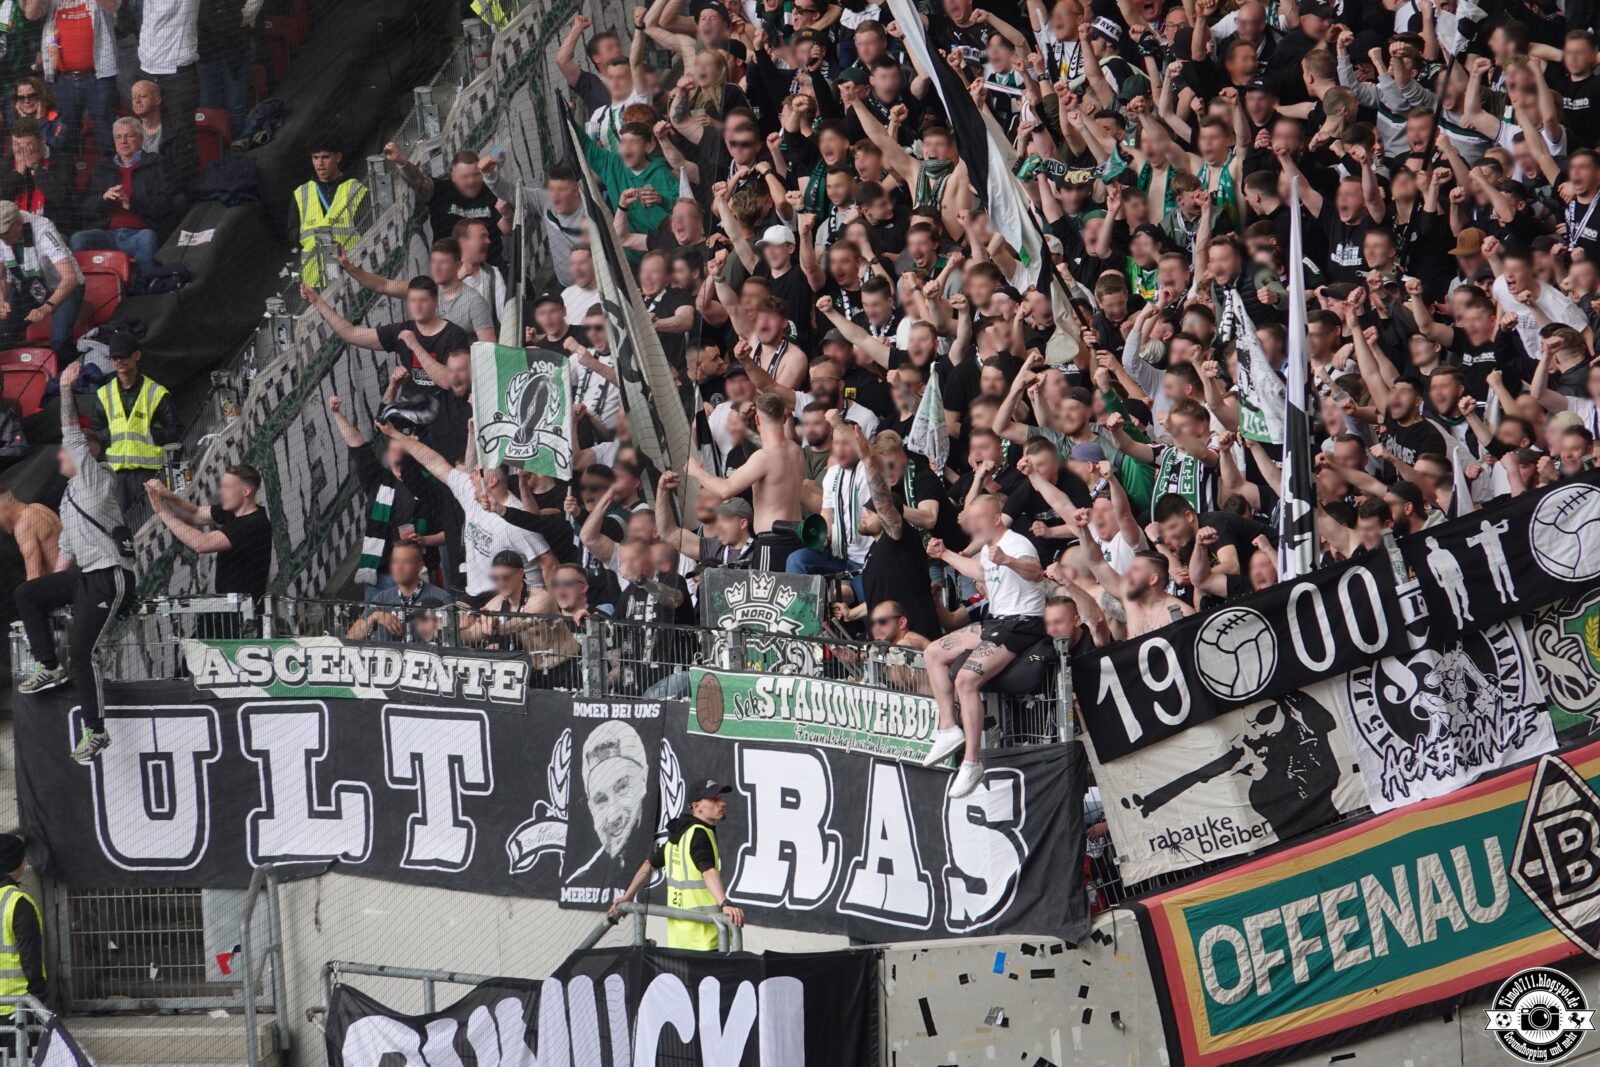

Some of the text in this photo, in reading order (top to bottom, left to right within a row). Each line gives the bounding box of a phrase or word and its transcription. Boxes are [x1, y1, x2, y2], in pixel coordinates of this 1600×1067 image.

[741, 609, 773, 620] NORD
[195, 645, 529, 705] ASCENDENTE
[573, 702, 661, 718] IMMER BEI UNS
[1382, 698, 1538, 801] ACKERBANDE
[1149, 816, 1233, 852] rabauke
[1198, 818, 1275, 854] bleiben
[560, 887, 600, 903] MEREU
[1198, 835, 1511, 1005] OFFENAU
